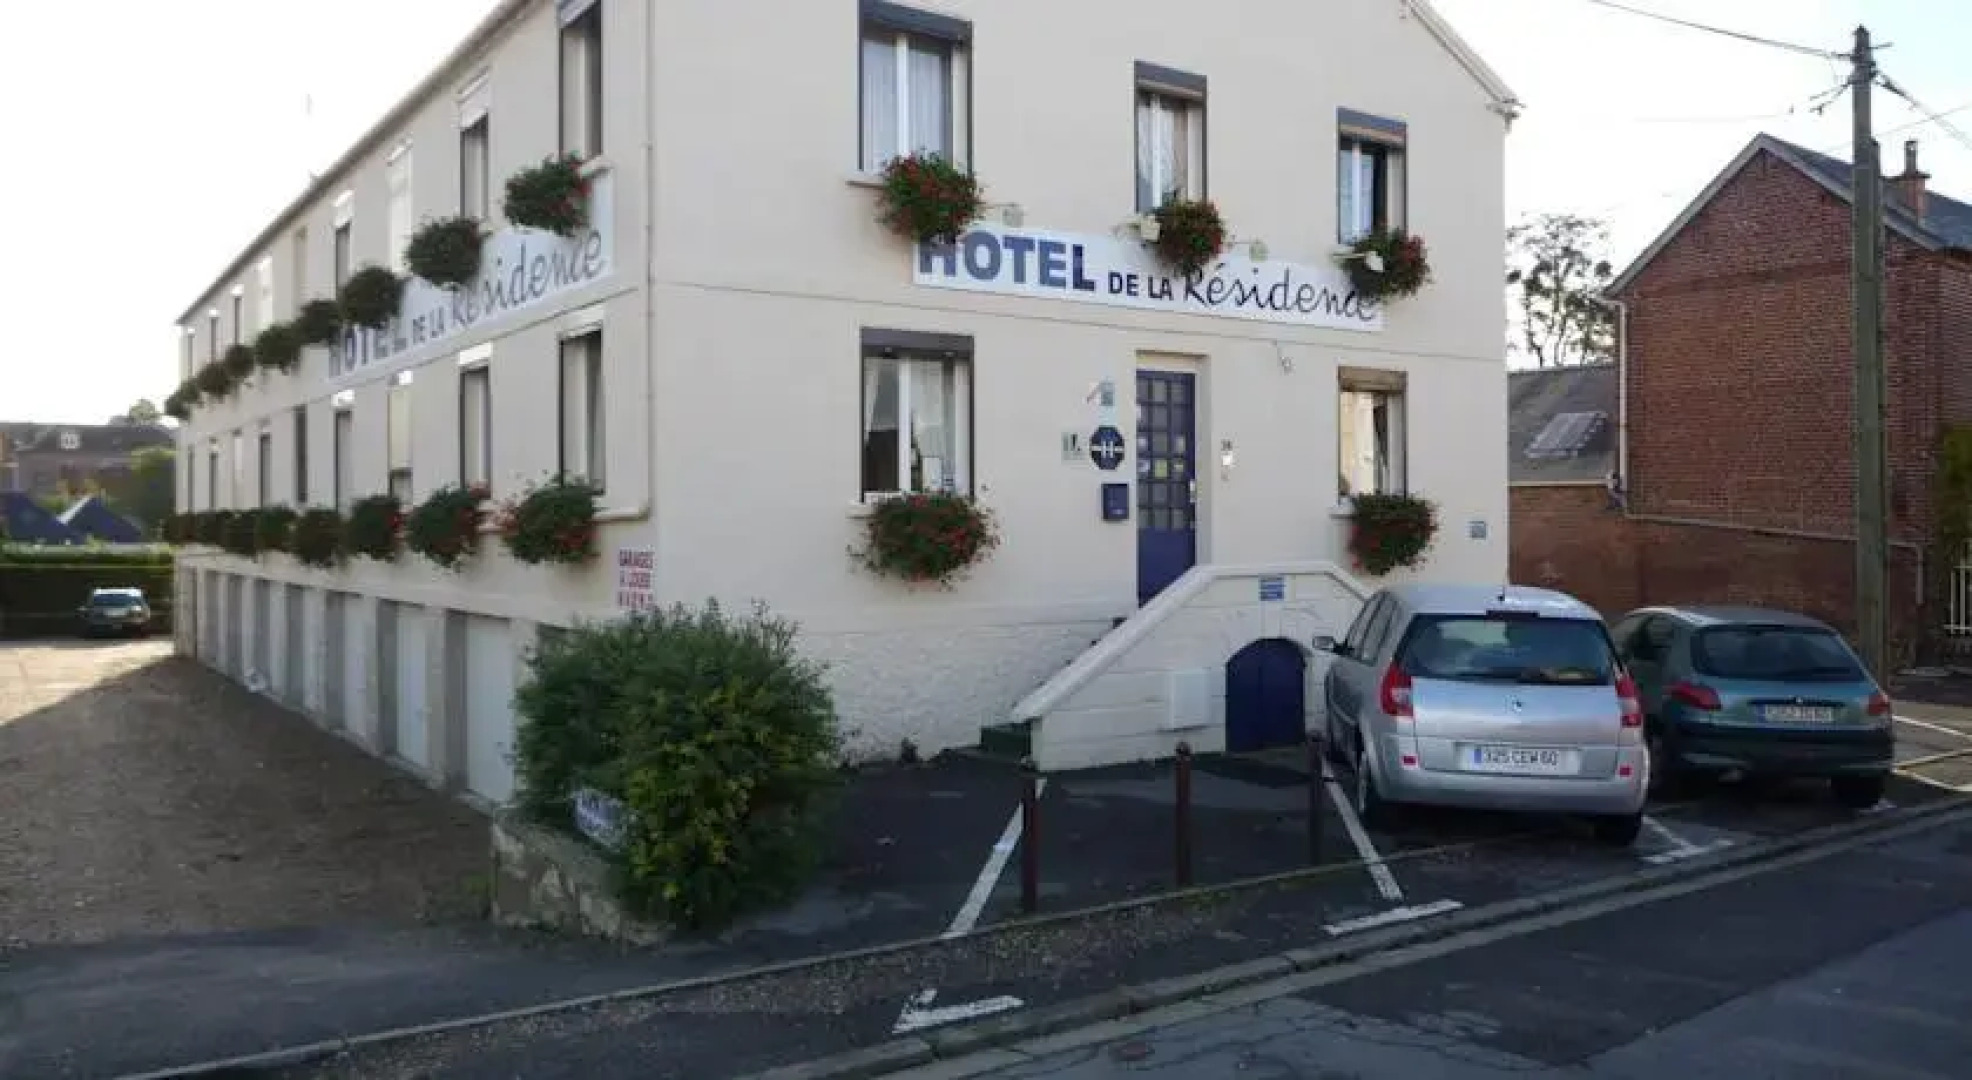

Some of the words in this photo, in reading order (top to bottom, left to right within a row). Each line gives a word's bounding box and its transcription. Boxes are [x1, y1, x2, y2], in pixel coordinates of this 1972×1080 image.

[919, 231, 1095, 291] HOTEL
[1108, 271, 1138, 296] DE
[1148, 275, 1174, 300] LA
[1183, 262, 1379, 321] Résidence
